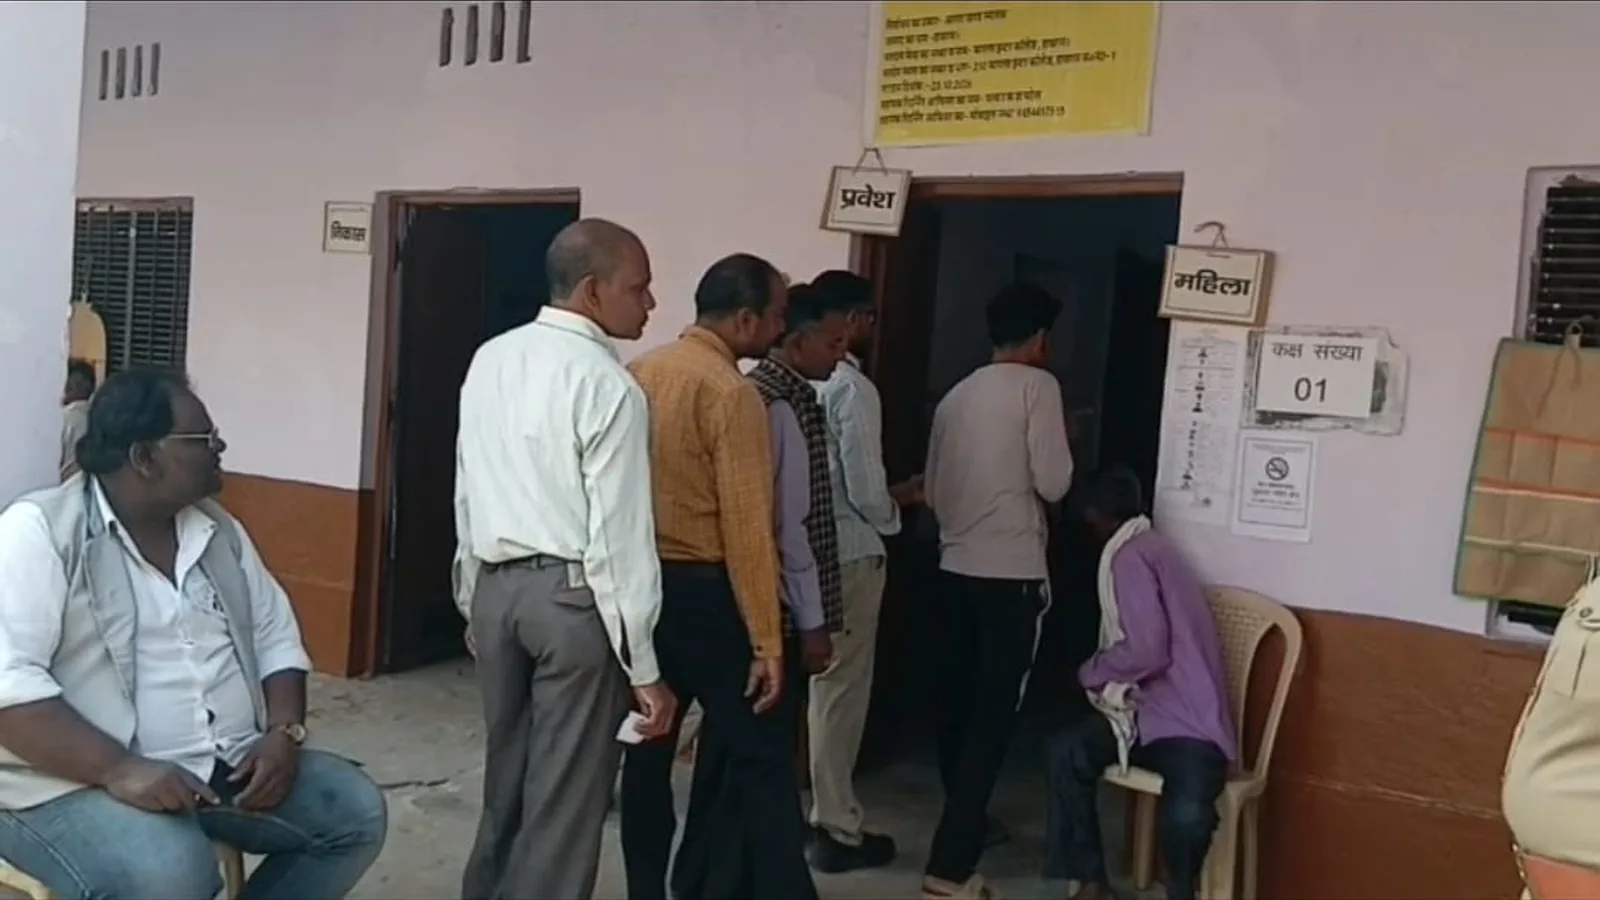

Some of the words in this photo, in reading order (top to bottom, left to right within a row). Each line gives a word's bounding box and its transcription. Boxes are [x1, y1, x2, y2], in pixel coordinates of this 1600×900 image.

[840, 183, 896, 210] प्रवेश
[331, 220, 367, 241] निकास
[1174, 268, 1252, 296] महिला
[1271, 342, 1304, 358] कक्ष
[1294, 377, 1327, 403] 01
